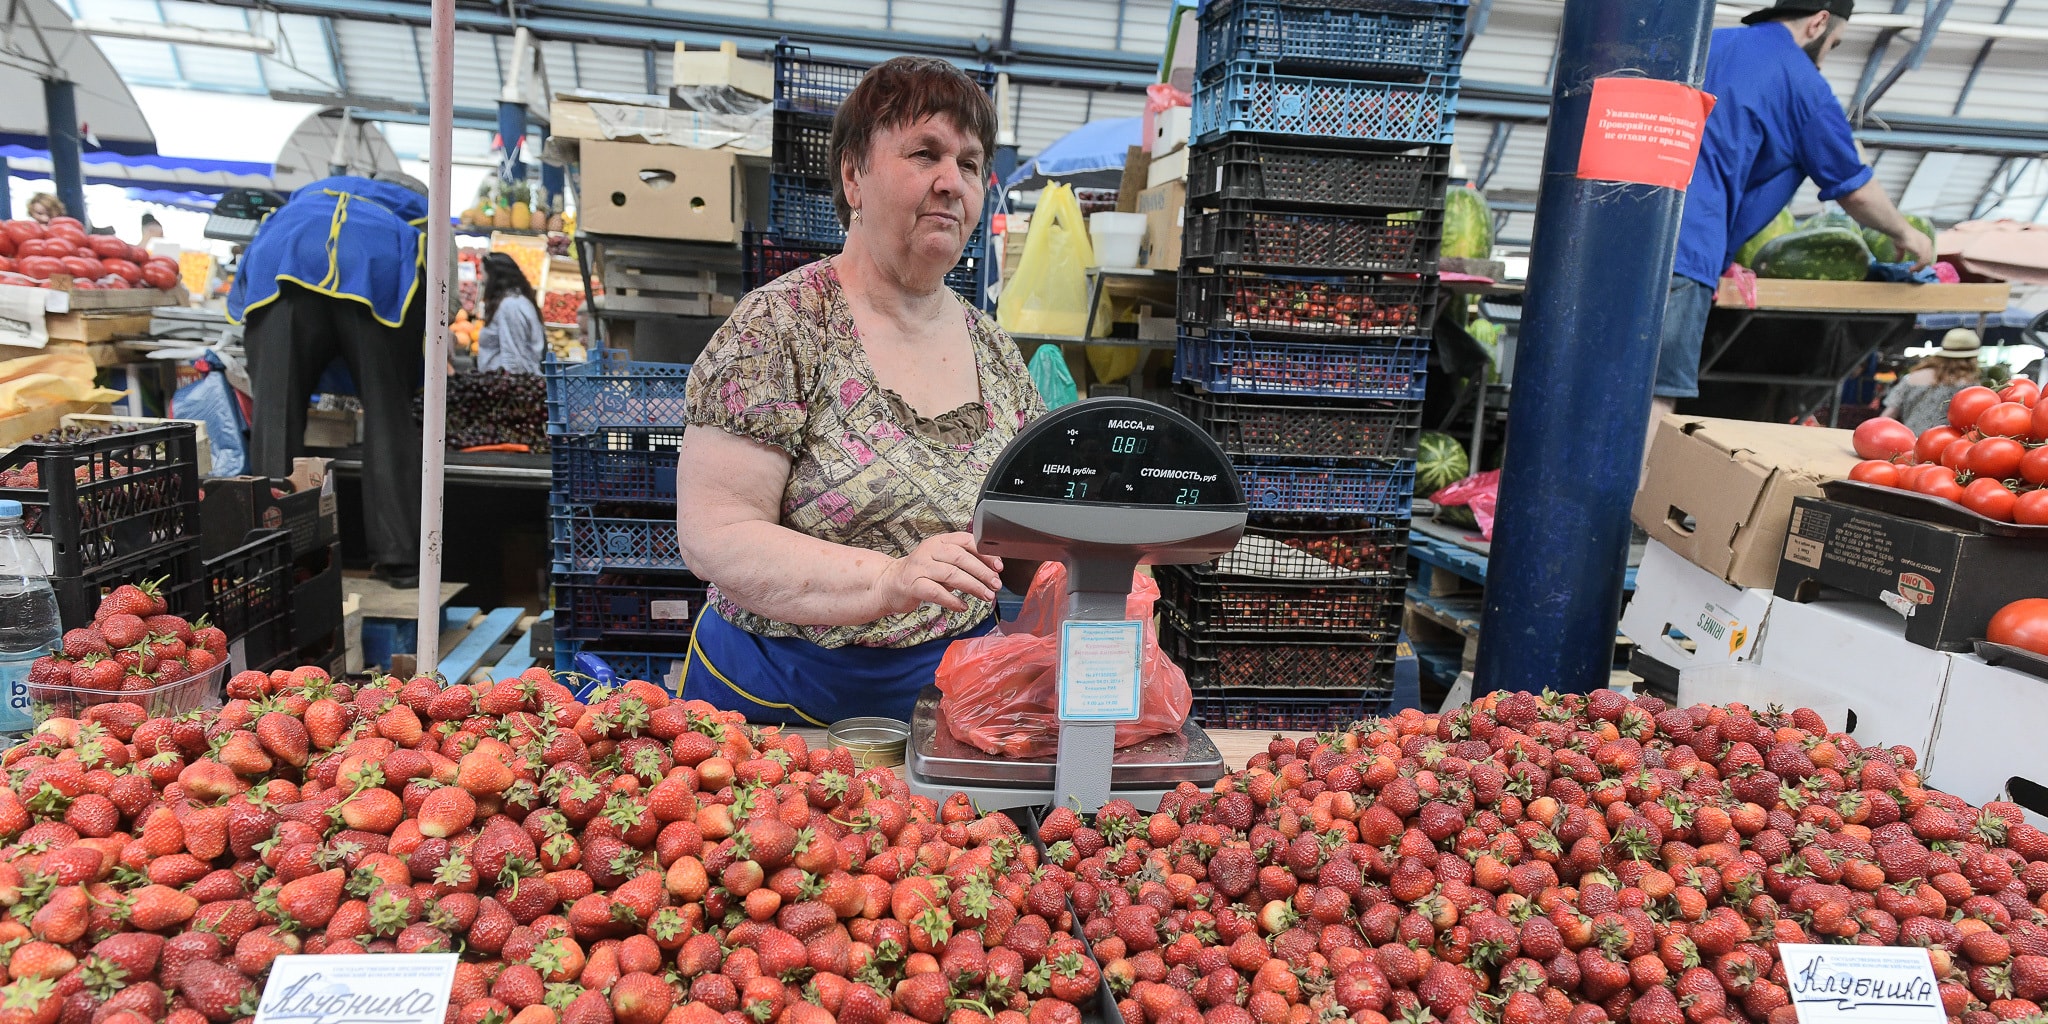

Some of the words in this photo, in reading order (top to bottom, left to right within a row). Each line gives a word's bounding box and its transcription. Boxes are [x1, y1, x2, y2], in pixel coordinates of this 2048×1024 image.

[1599, 120, 1652, 132] Проверяйте
[1604, 132, 1615, 140] не
[1617, 133, 1646, 142] отходя
[1648, 135, 1658, 143] от
[1108, 418, 1146, 430] МАССА,
[1042, 464, 1070, 475] ЦЕНА
[1072, 466, 1096, 476] руб/кг
[1876, 568, 1893, 576] GROUP
[1921, 564, 1942, 573] PRODUCT
[1697, 613, 1726, 640] IRINA'S
